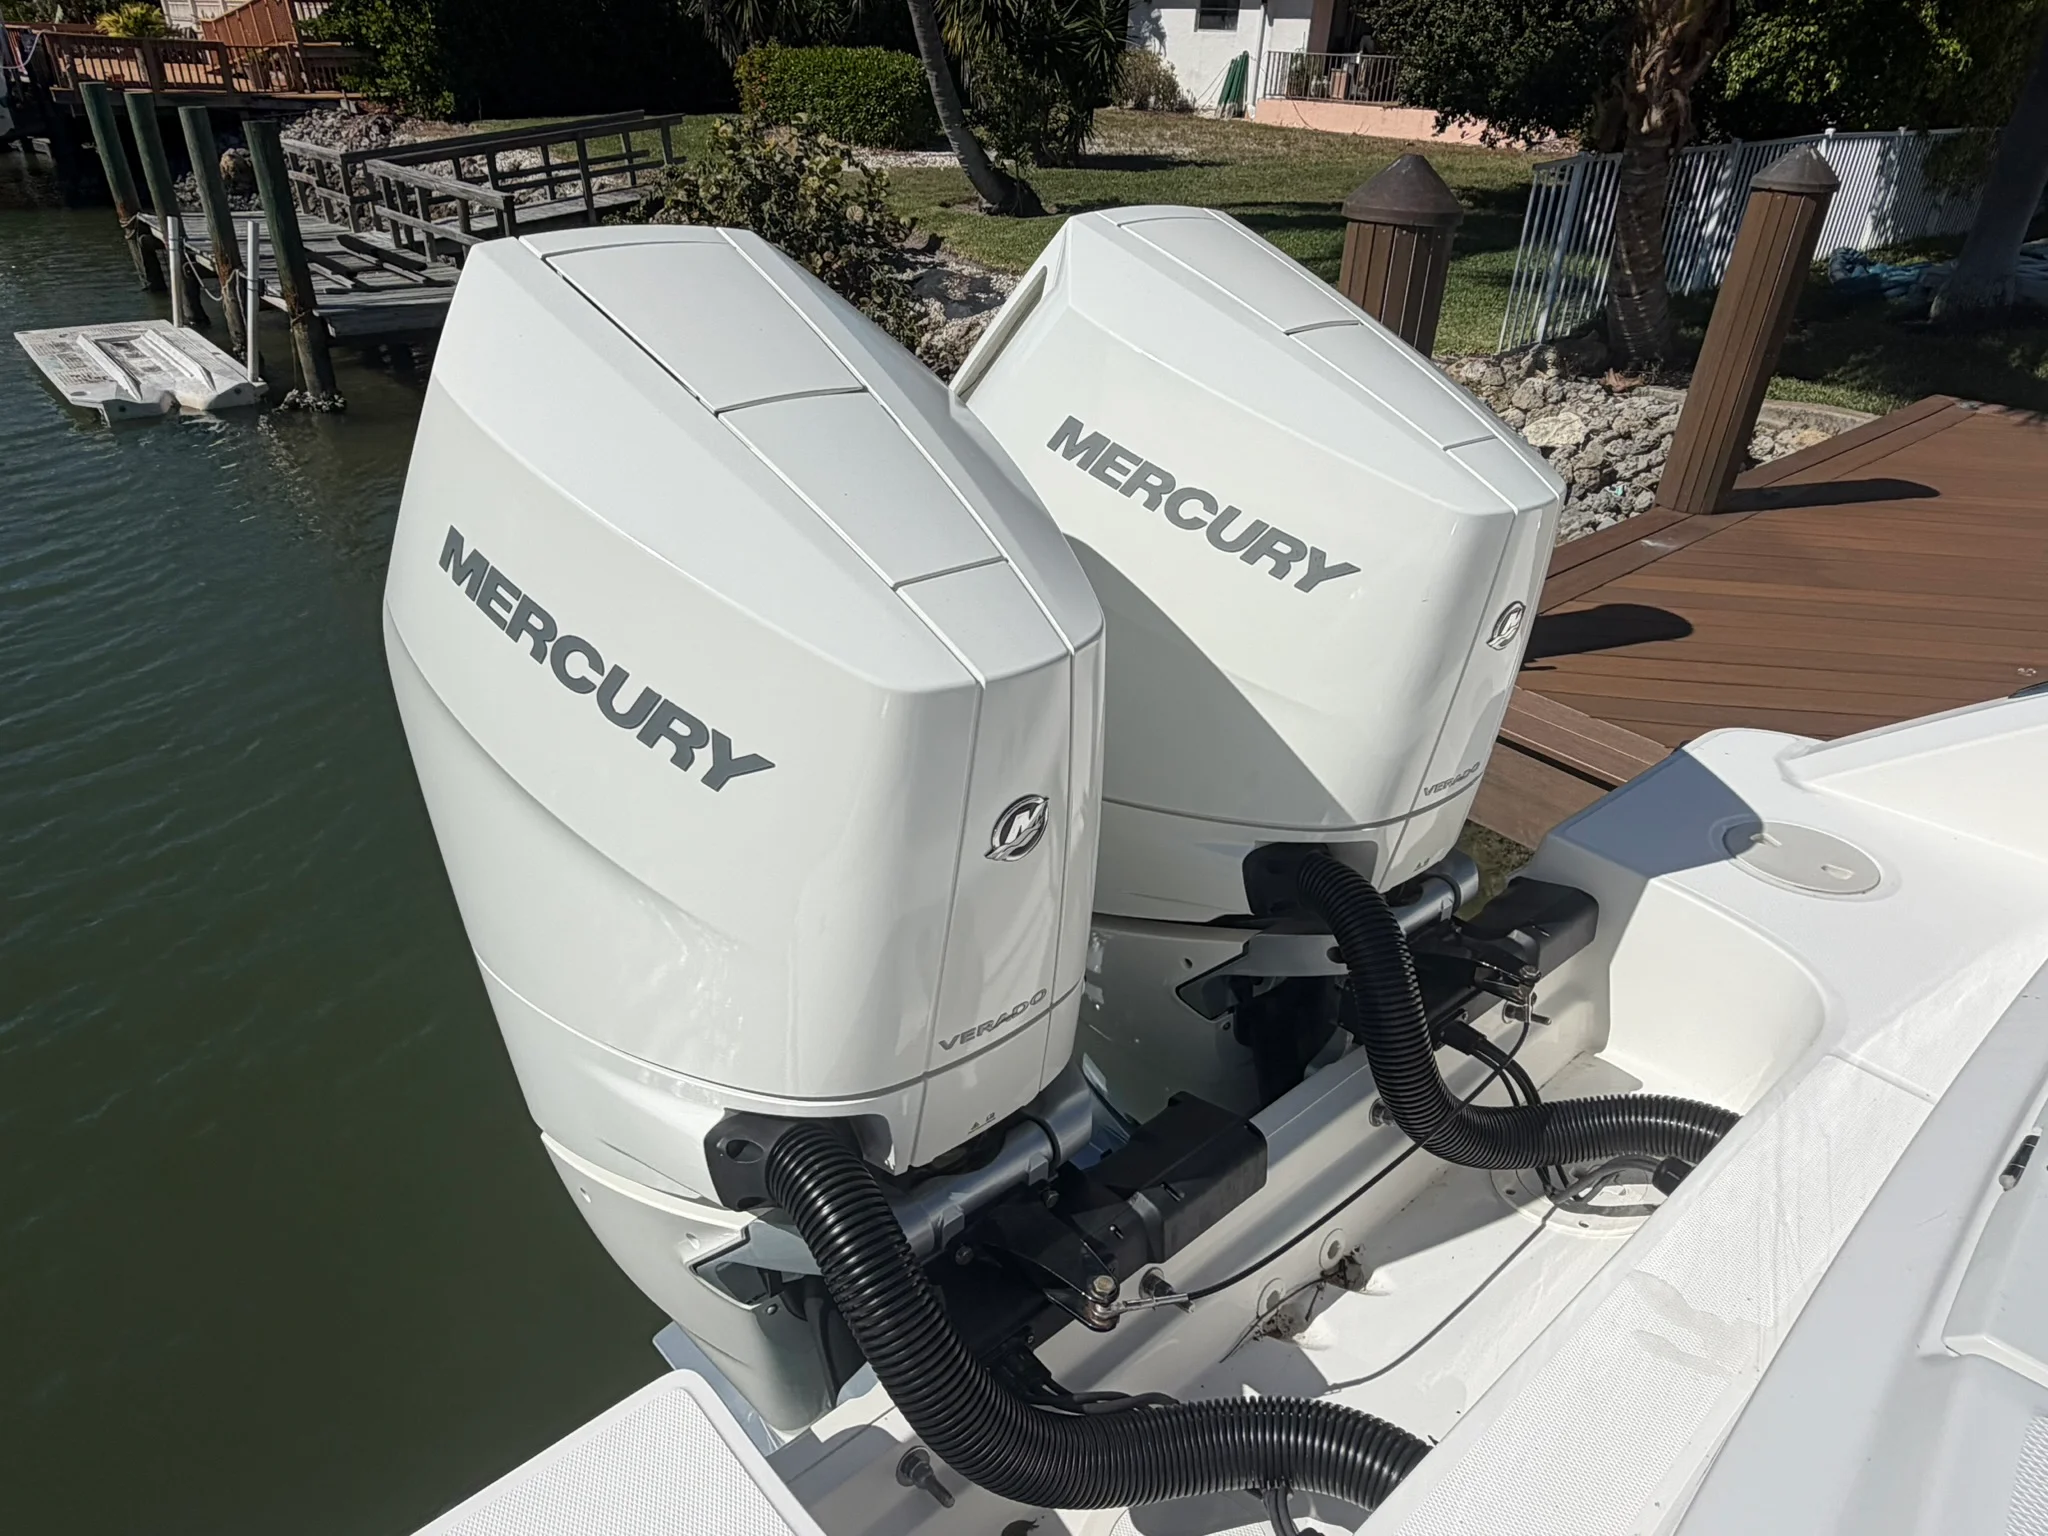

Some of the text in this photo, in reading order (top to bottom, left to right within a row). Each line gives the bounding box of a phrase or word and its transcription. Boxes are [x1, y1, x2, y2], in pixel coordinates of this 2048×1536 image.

[1046, 415, 1362, 593] MERCURY
[438, 524, 776, 792] MERCURY
[1423, 761, 1481, 797] VERADO
[938, 987, 1048, 1051] VERADO
